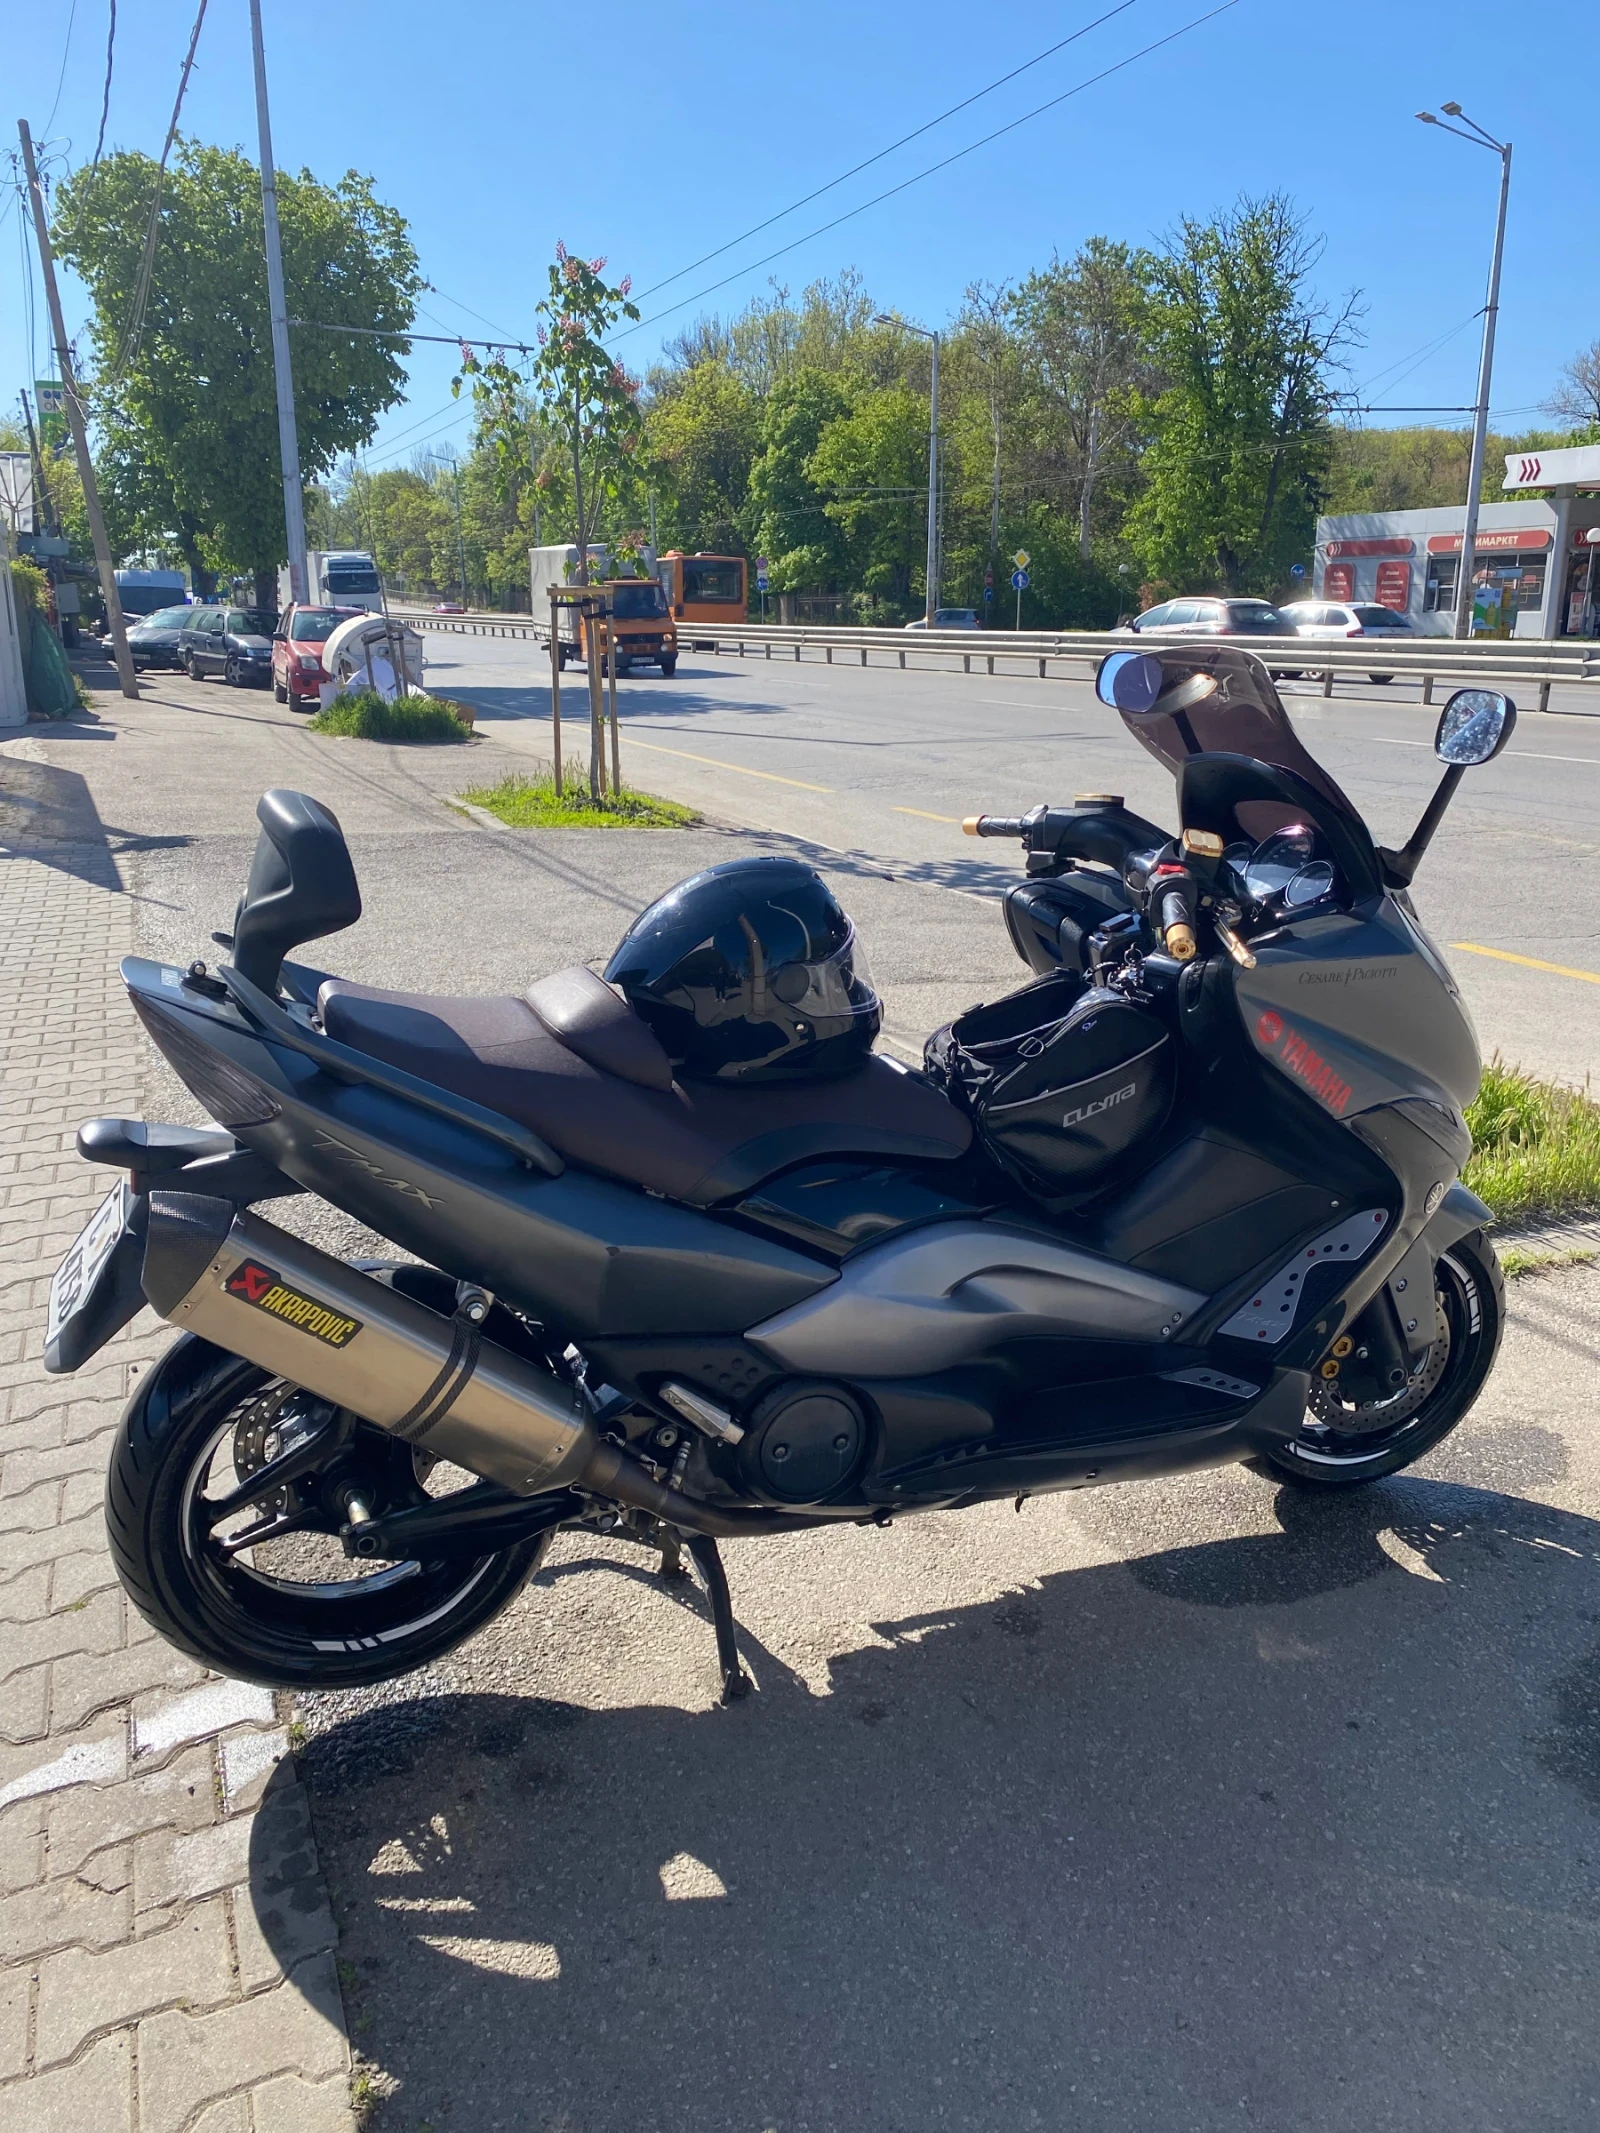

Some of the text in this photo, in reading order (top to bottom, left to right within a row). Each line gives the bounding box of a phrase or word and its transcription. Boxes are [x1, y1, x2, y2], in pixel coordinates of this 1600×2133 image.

[1453, 535, 1519, 549] МИМАРКЕТ
[1280, 1029, 1352, 1115] YAMAHA
[57, 1245, 84, 1323] 4758
